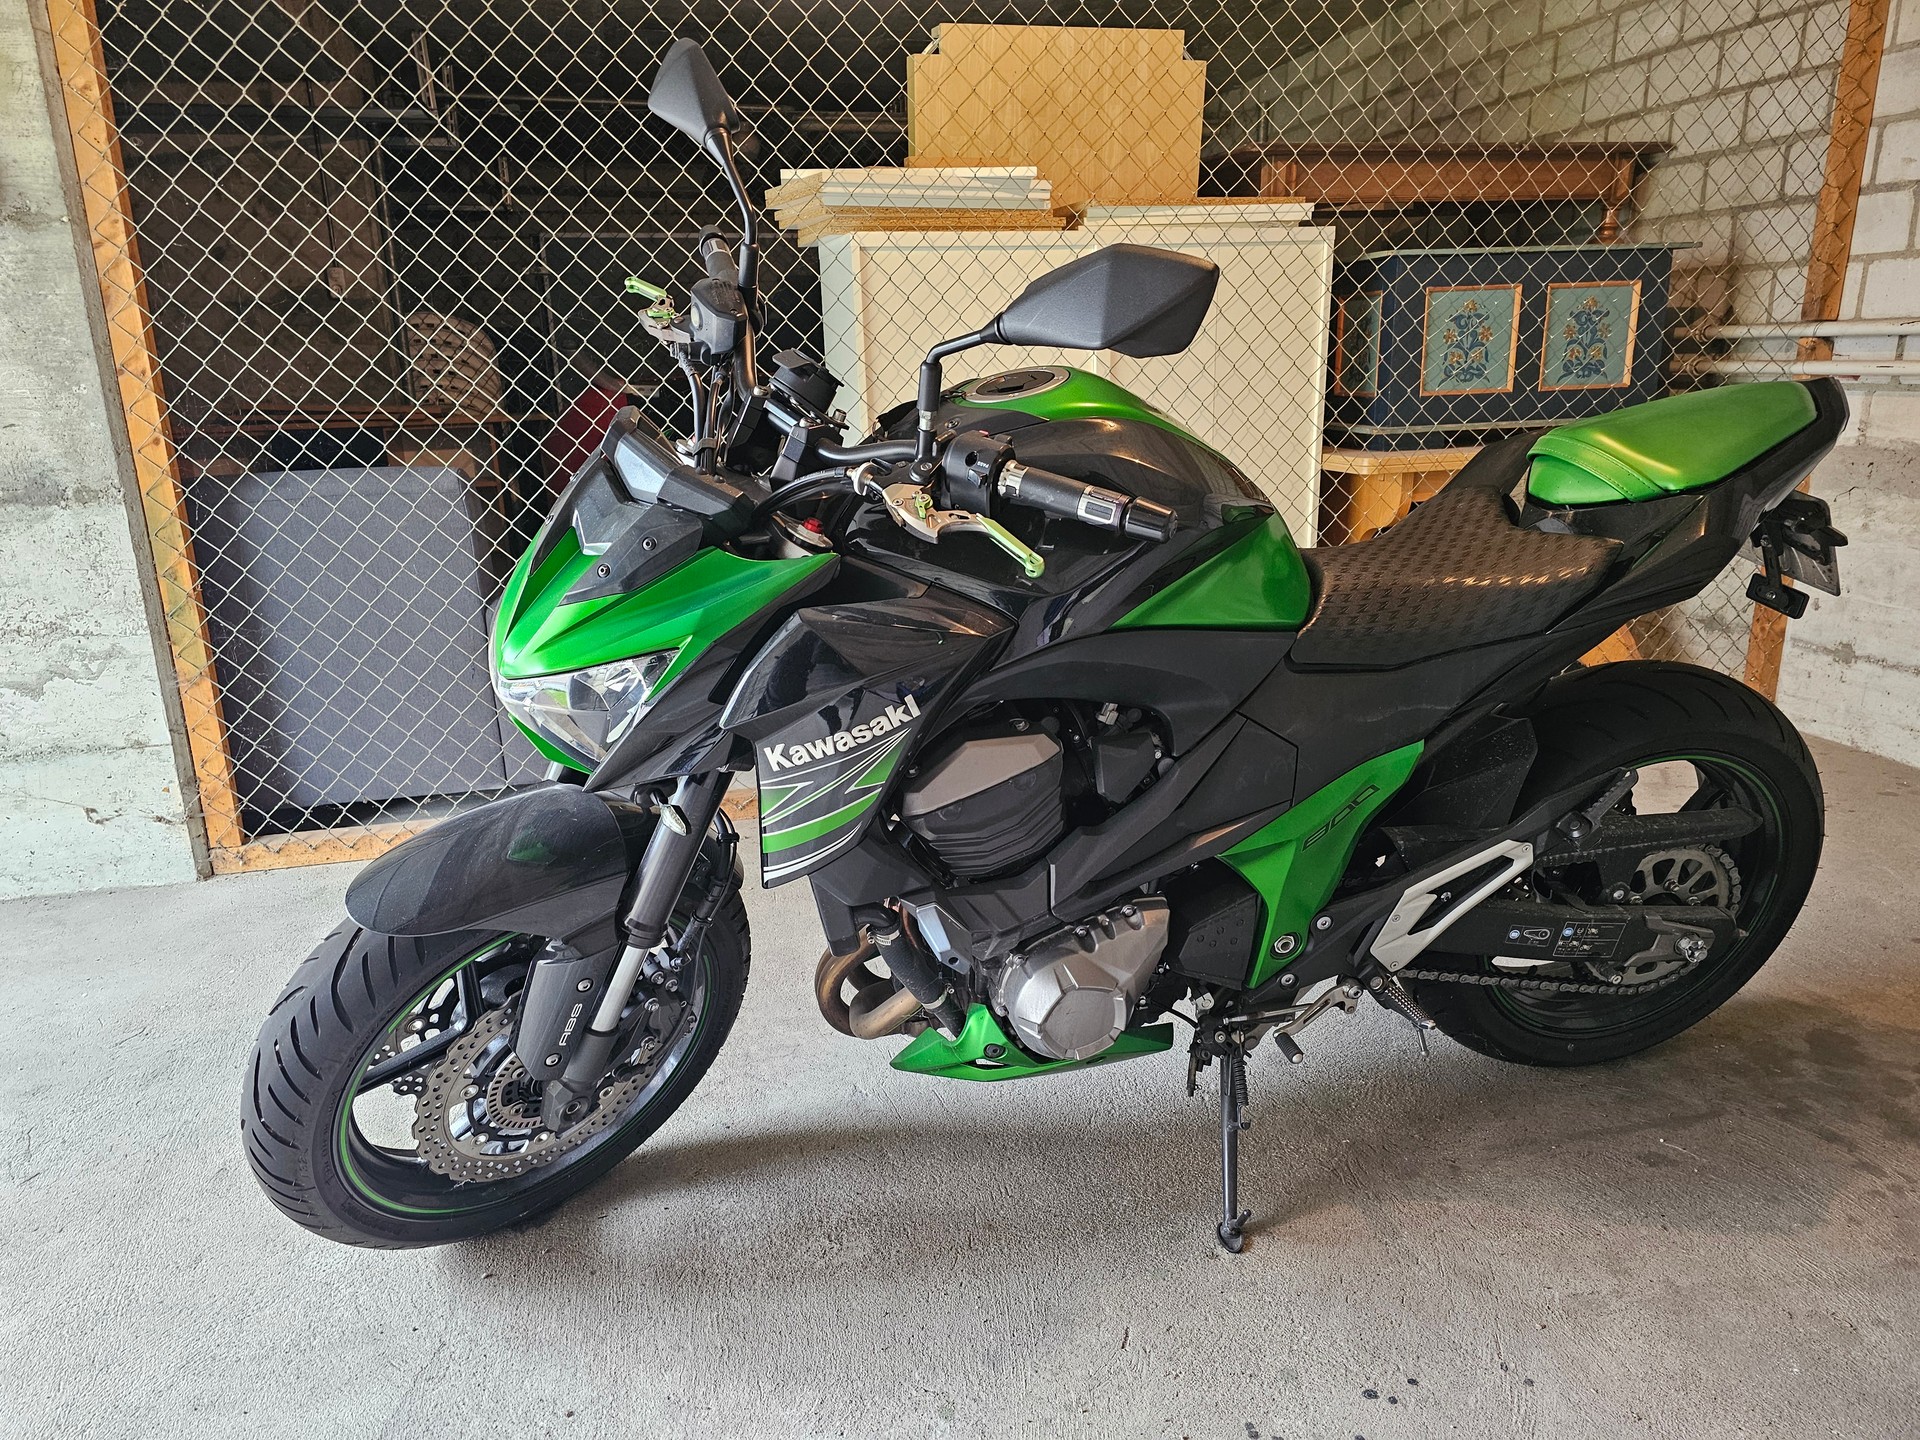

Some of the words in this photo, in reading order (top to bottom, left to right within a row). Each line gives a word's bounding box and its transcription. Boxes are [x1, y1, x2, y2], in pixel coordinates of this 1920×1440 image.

[763, 693, 922, 773] Kawasaki
[1301, 784, 1381, 853] 800
[558, 1003, 583, 1047] ABS
